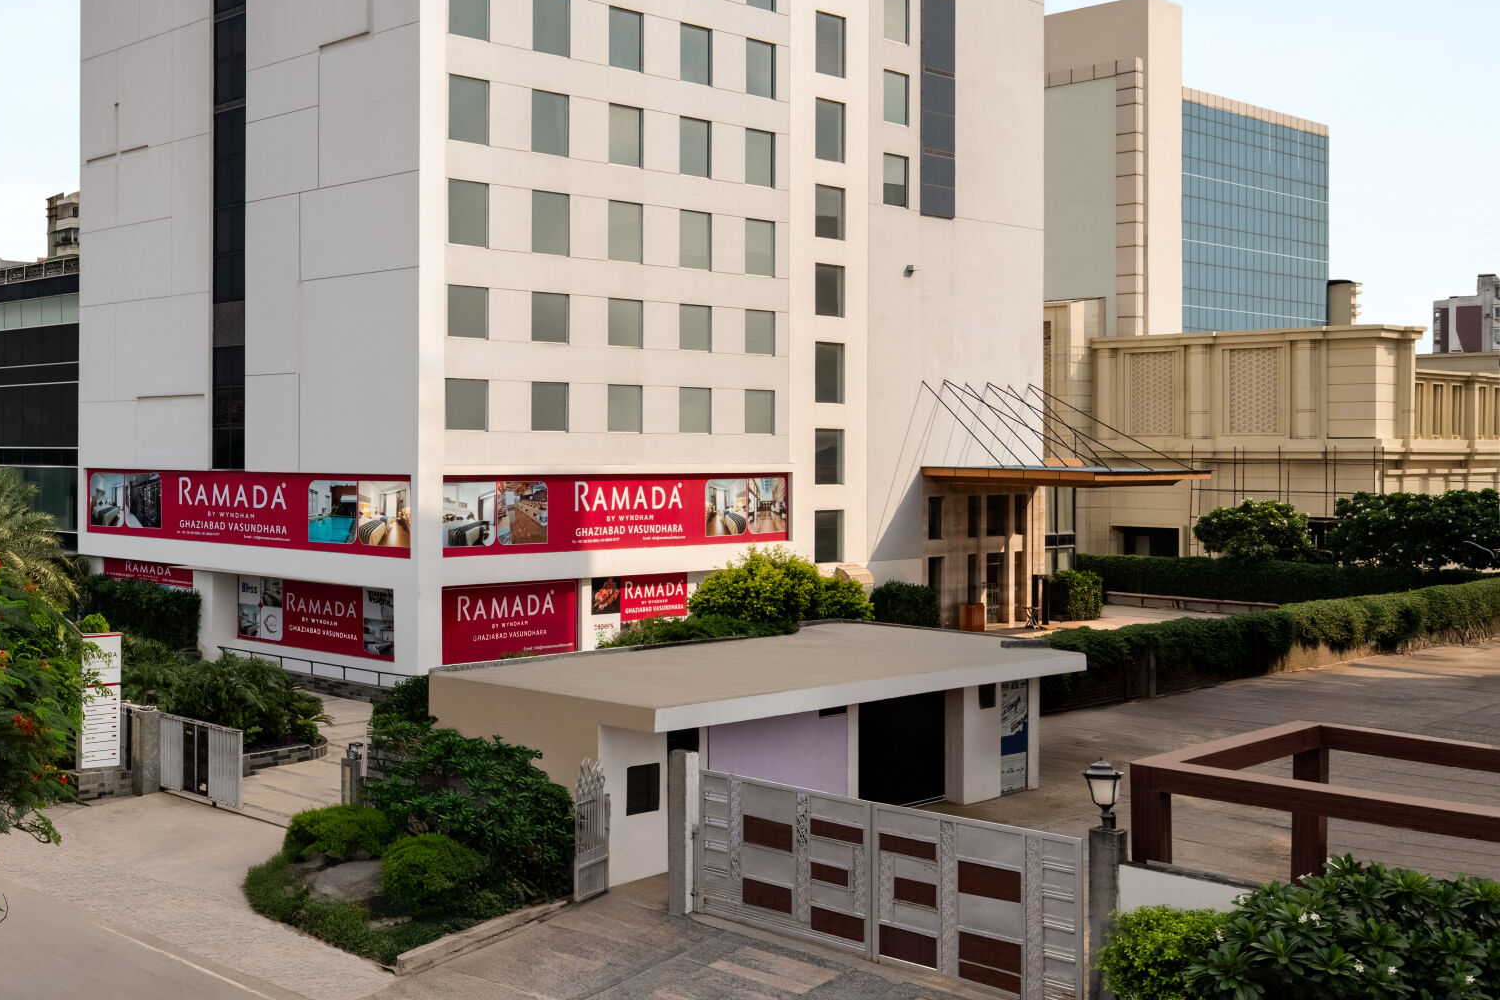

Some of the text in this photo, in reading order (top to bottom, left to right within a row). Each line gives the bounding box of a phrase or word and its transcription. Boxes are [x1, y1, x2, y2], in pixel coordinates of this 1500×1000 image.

[179, 476, 287, 510] RAMADA
[574, 481, 682, 512] RAMADA
[219, 511, 255, 519] WYNDHAM
[179, 520, 226, 531] GHAZIABAD
[228, 522, 287, 534] VASUNDHARA
[575, 524, 683, 537] GHAZIABAD VASUNDHARA
[125, 561, 171, 576] RAMADA
[624, 580, 684, 600] RAMADA
[286, 592, 357, 618] RAMADA
[457, 591, 555, 622] RAMADA
[625, 606, 652, 614] GHAZIABAD
[311, 617, 338, 627] WYNDHAM
[501, 620, 529, 628] WYNDHAM
[288, 624, 358, 641] GHAZIABAD VASUNDHARA
[472, 629, 547, 642] GHAZIABAD VASUNDHARA
